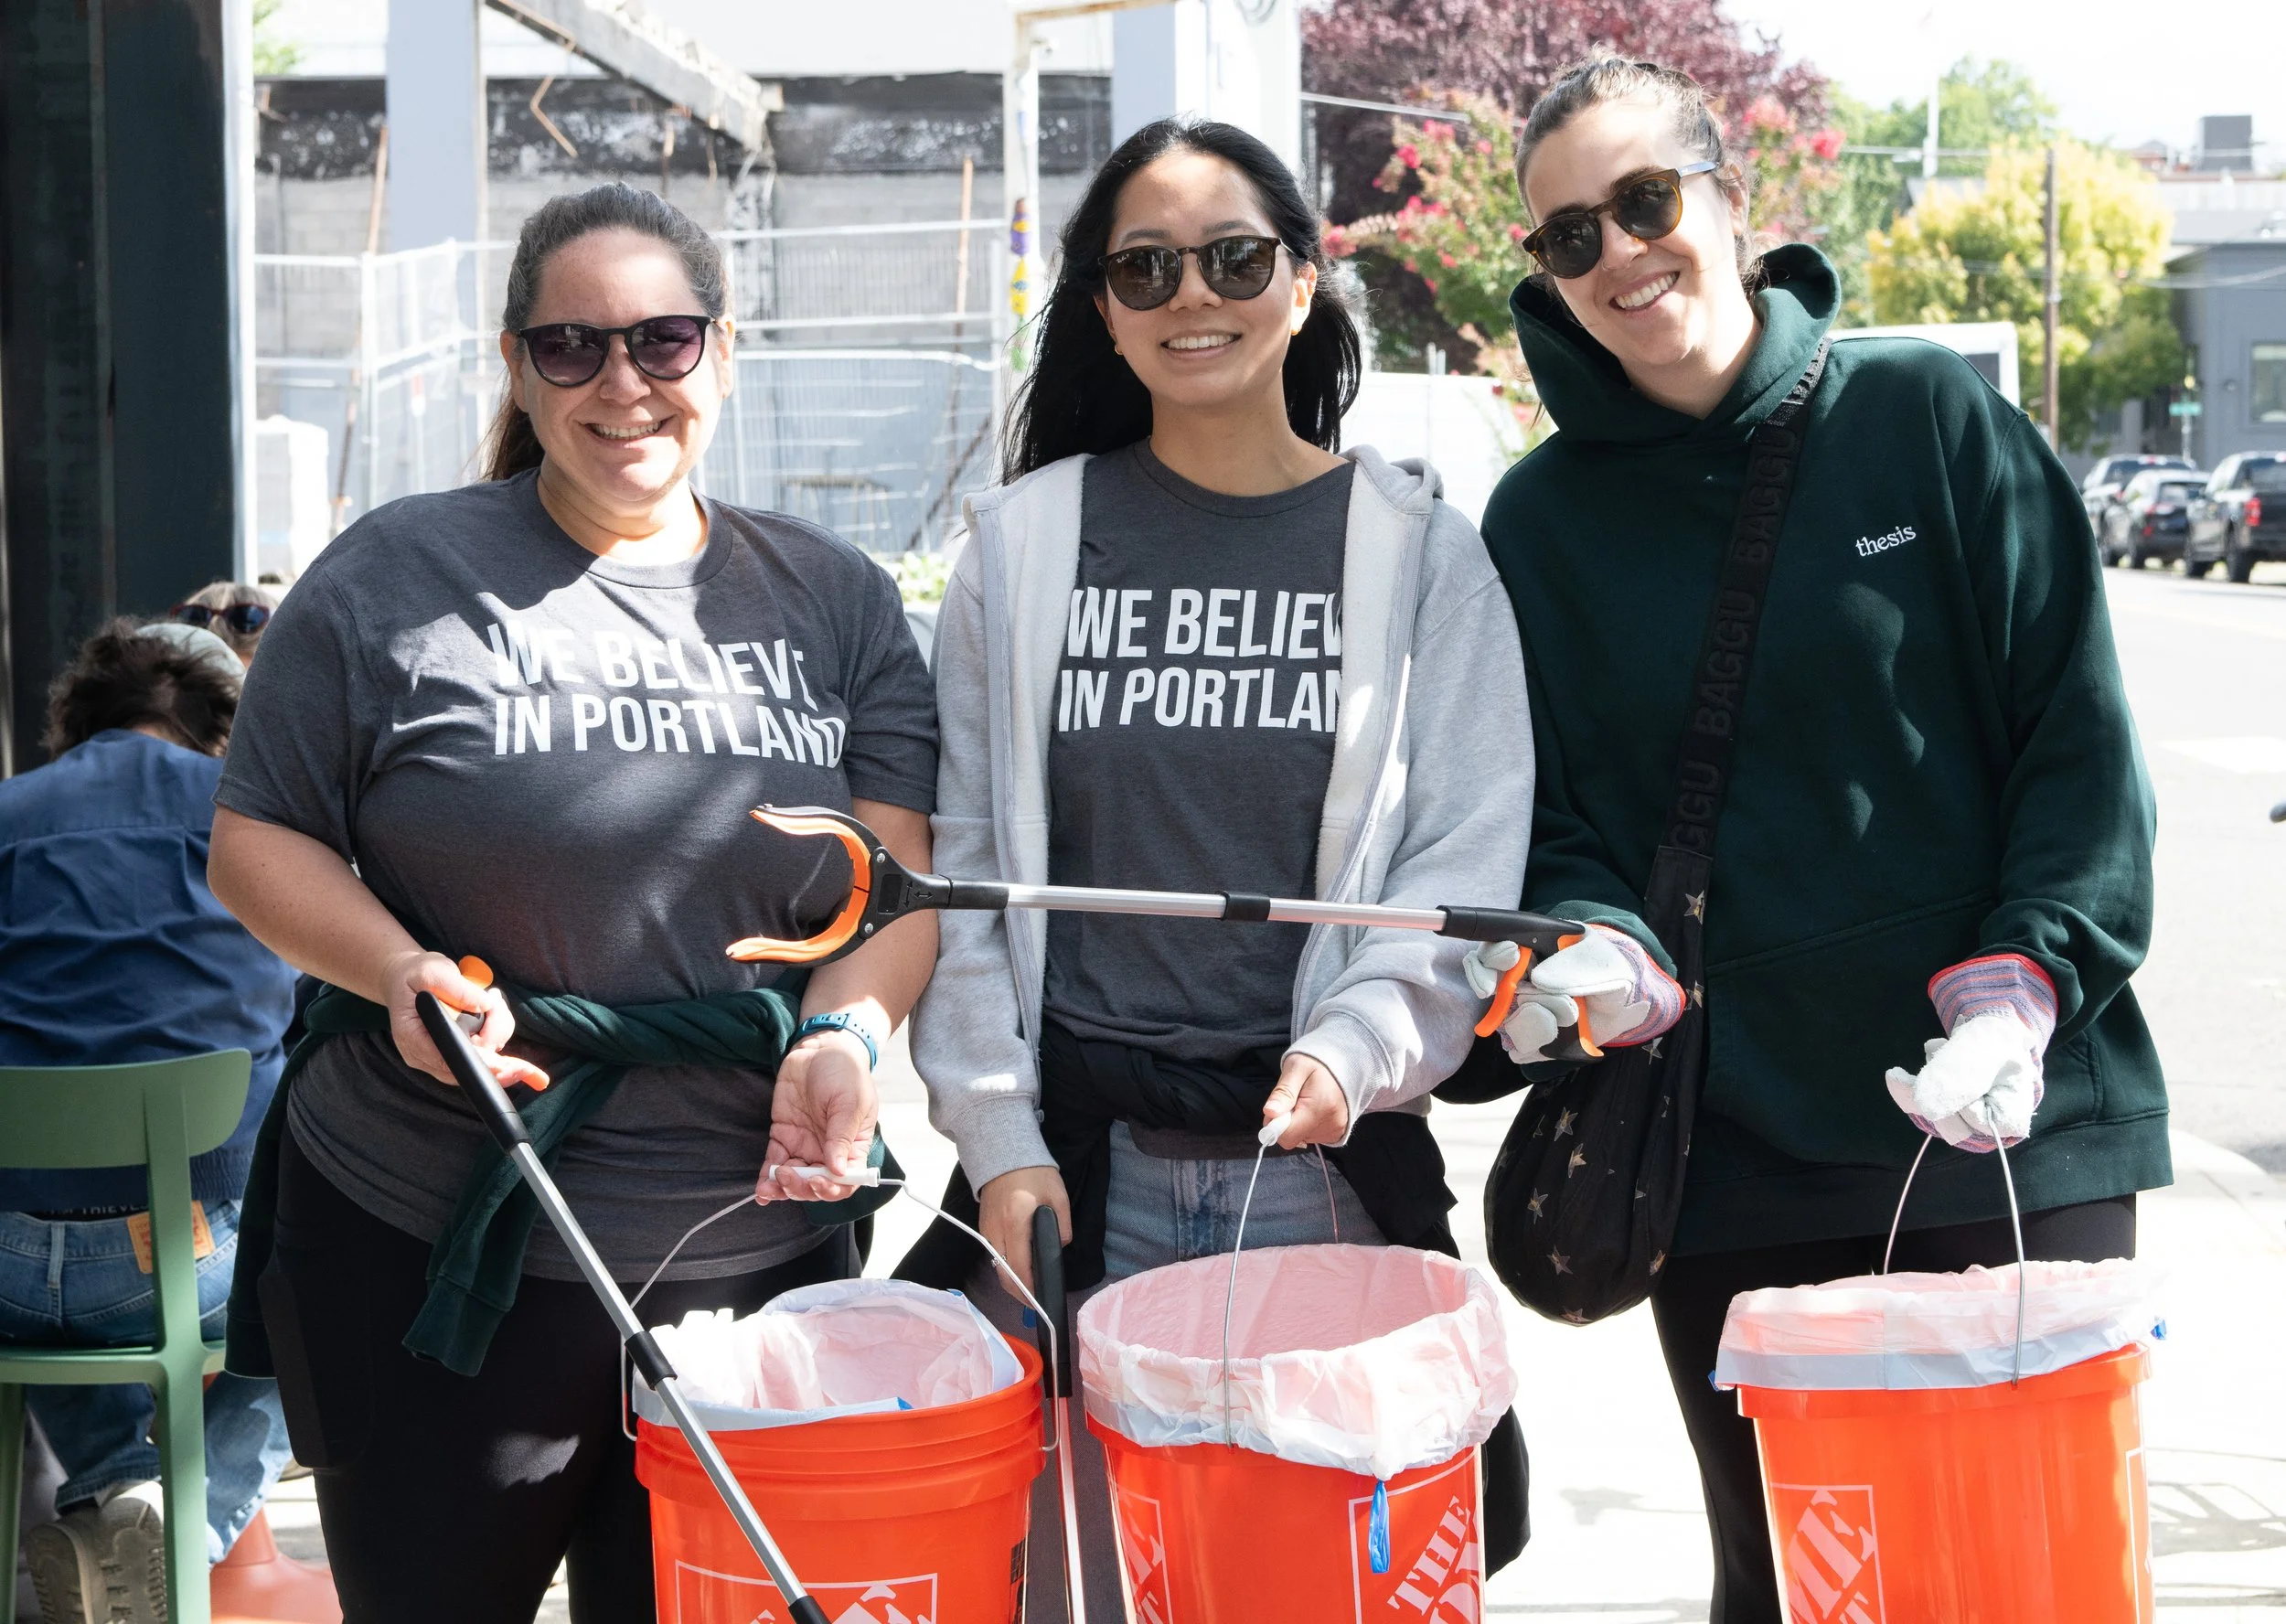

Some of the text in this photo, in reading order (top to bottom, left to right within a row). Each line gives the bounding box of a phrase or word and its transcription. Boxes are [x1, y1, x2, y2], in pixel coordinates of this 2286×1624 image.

[1855, 526, 1917, 557] thesis
[487, 620, 585, 687] WE
[1067, 586, 1153, 658] WE
[1693, 587, 1757, 735] BAGGU
[495, 693, 847, 769] IN PORTLAND
[1058, 669, 1109, 732] IN
[1386, 1495, 1471, 1617] THE
